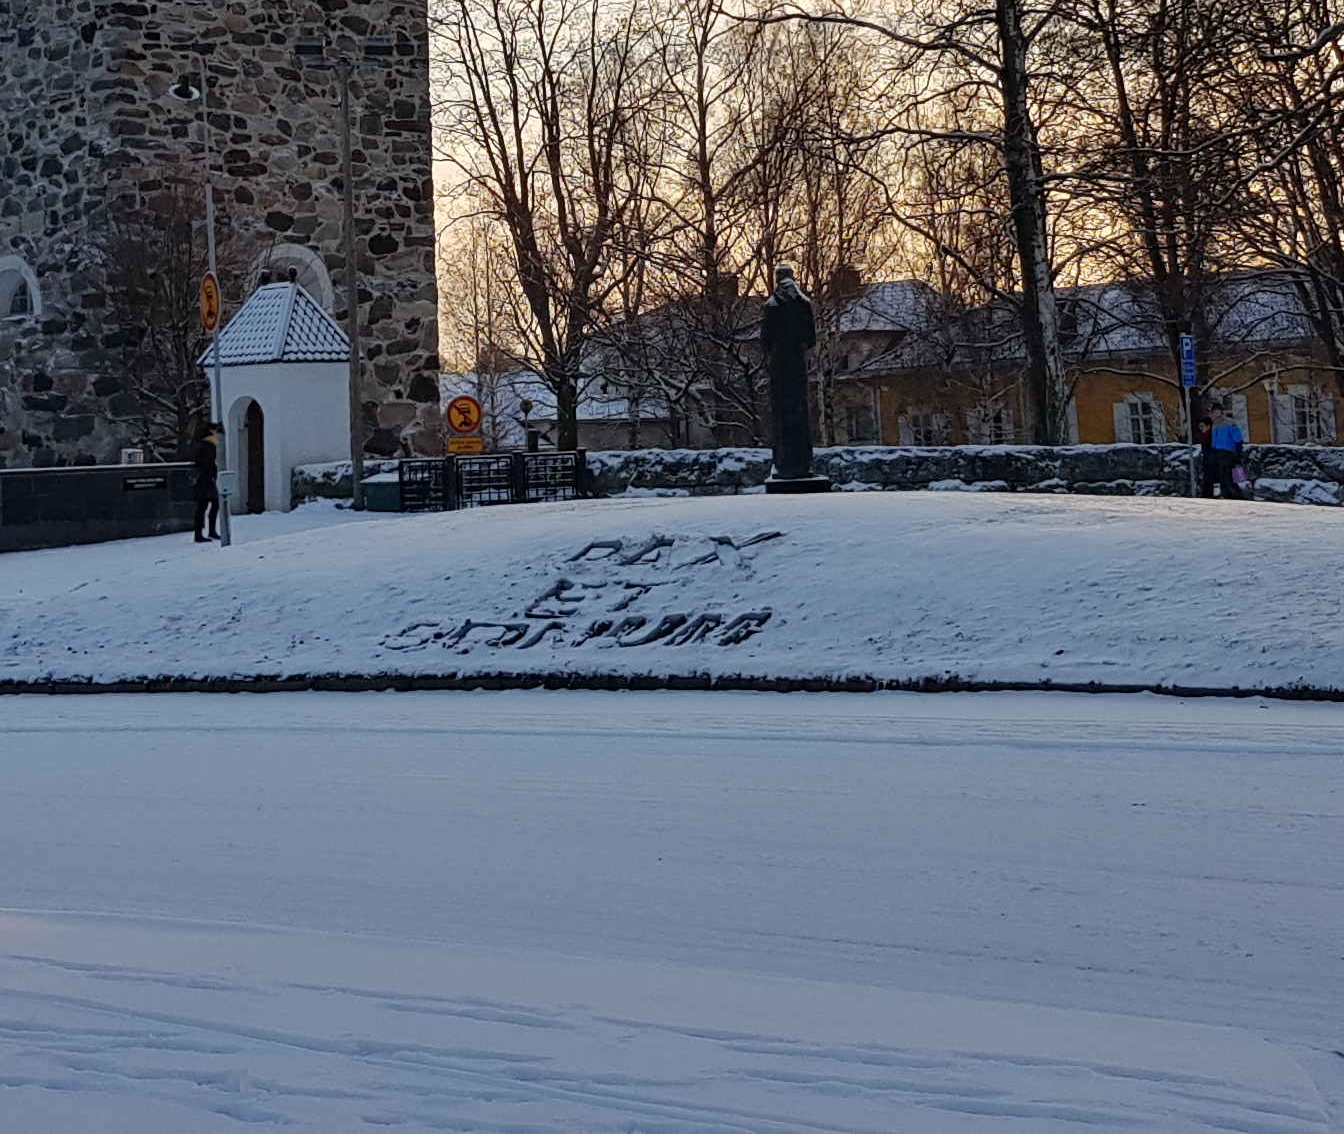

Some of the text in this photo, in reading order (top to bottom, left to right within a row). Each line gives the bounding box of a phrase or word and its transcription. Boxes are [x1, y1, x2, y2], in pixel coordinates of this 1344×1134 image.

[1182, 337, 1192, 359] P
[563, 531, 784, 571] PAX
[524, 579, 690, 618] ET
